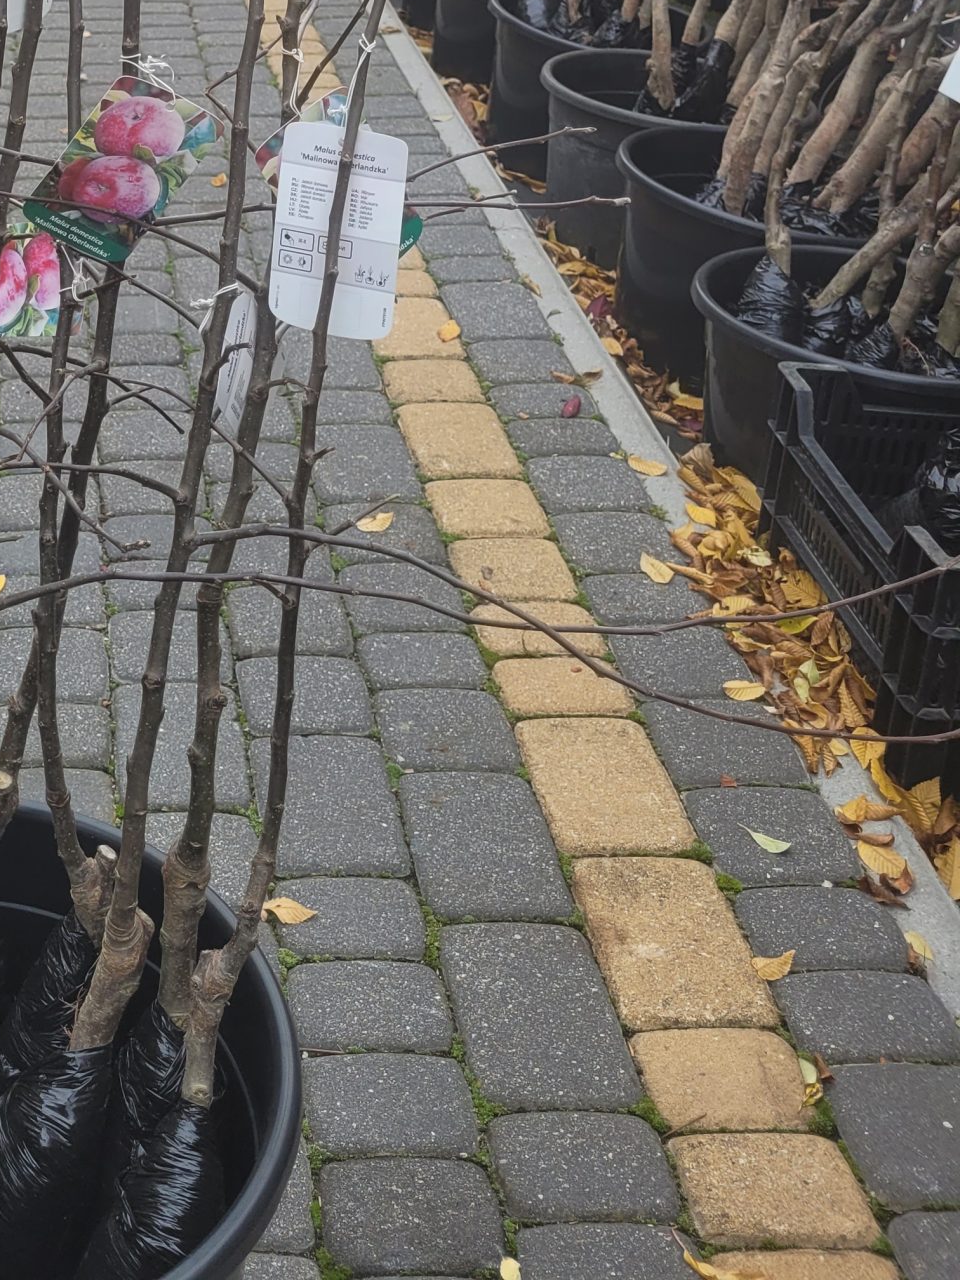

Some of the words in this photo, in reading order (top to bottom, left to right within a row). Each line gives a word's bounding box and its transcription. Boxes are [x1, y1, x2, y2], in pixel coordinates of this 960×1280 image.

[314, 145, 337, 156] Malus
[300, 152, 338, 166] 'Malinowa
[49, 215, 71, 229] Malus
[70, 225, 104, 246] domestica
